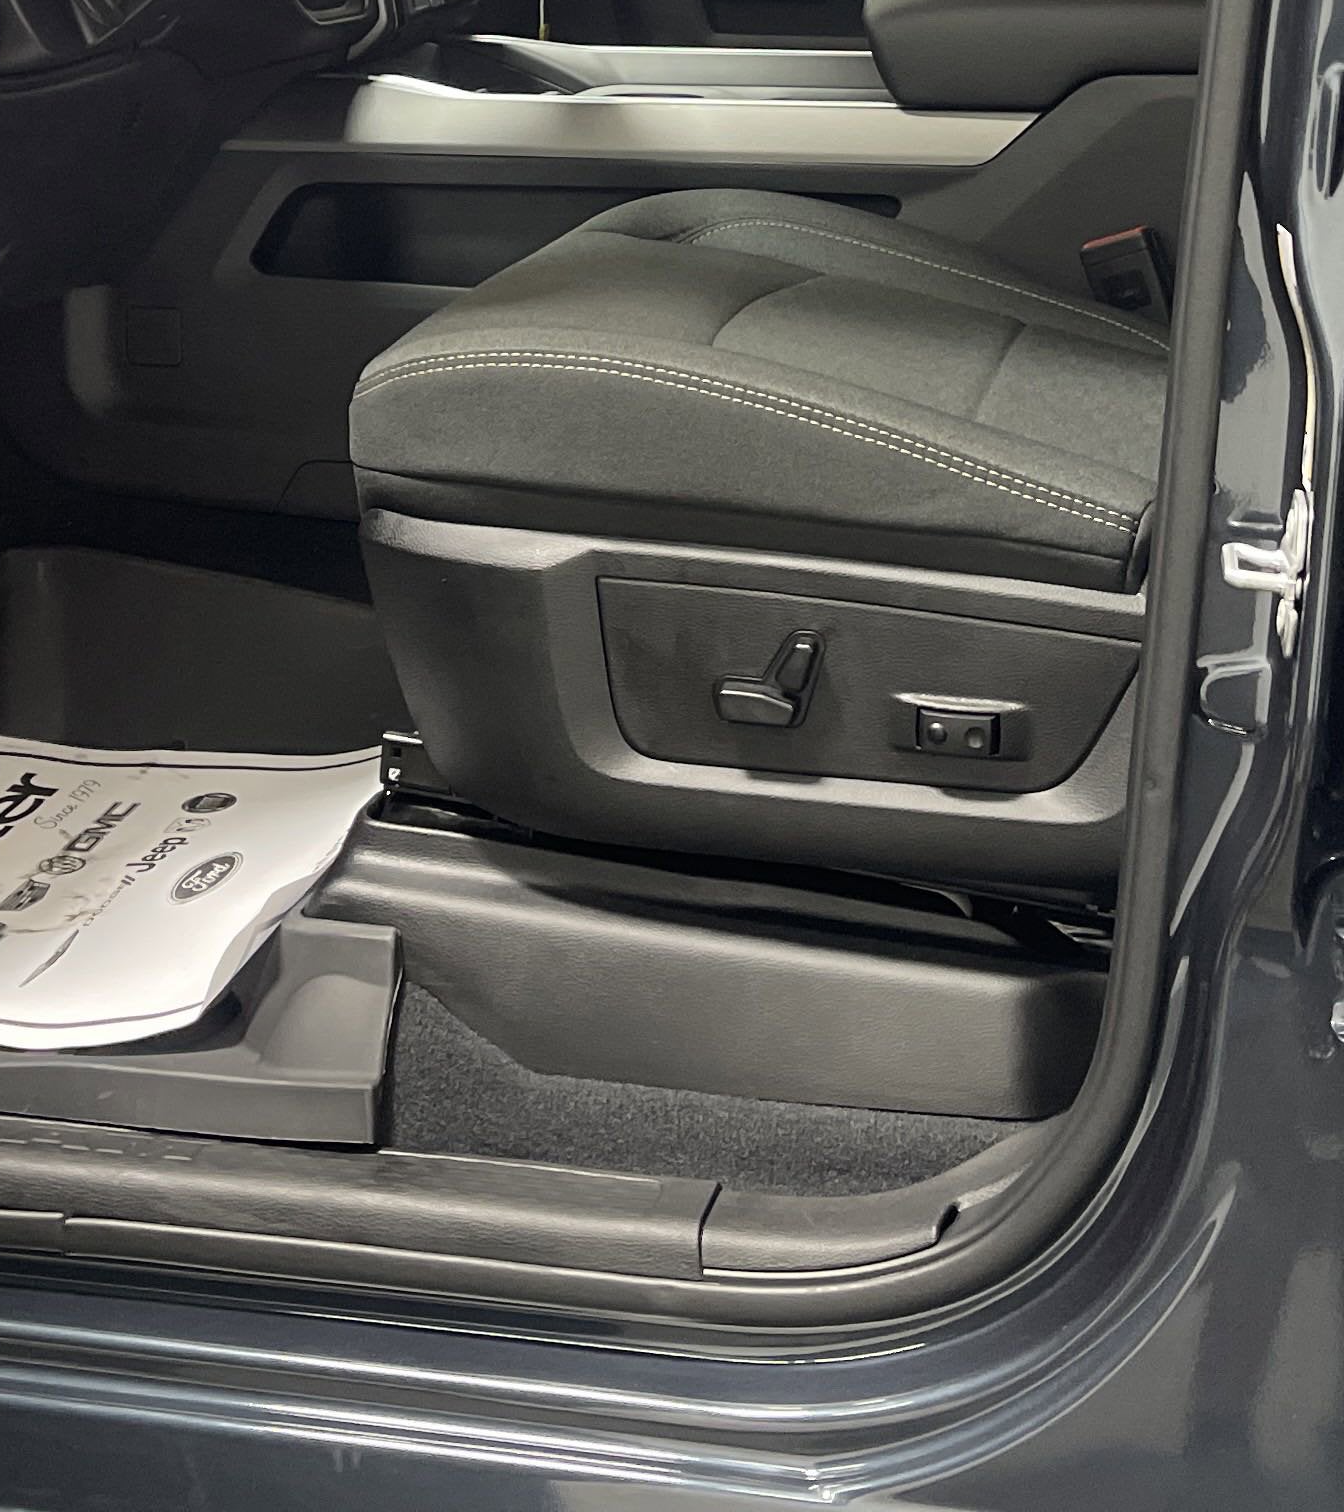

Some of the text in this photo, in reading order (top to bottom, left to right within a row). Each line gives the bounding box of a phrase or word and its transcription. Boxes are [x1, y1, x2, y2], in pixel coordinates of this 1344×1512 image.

[33, 779, 102, 829] Since 1979
[64, 801, 142, 852] GMC
[126, 837, 190, 873] Jeep
[181, 861, 232, 893] Ford
